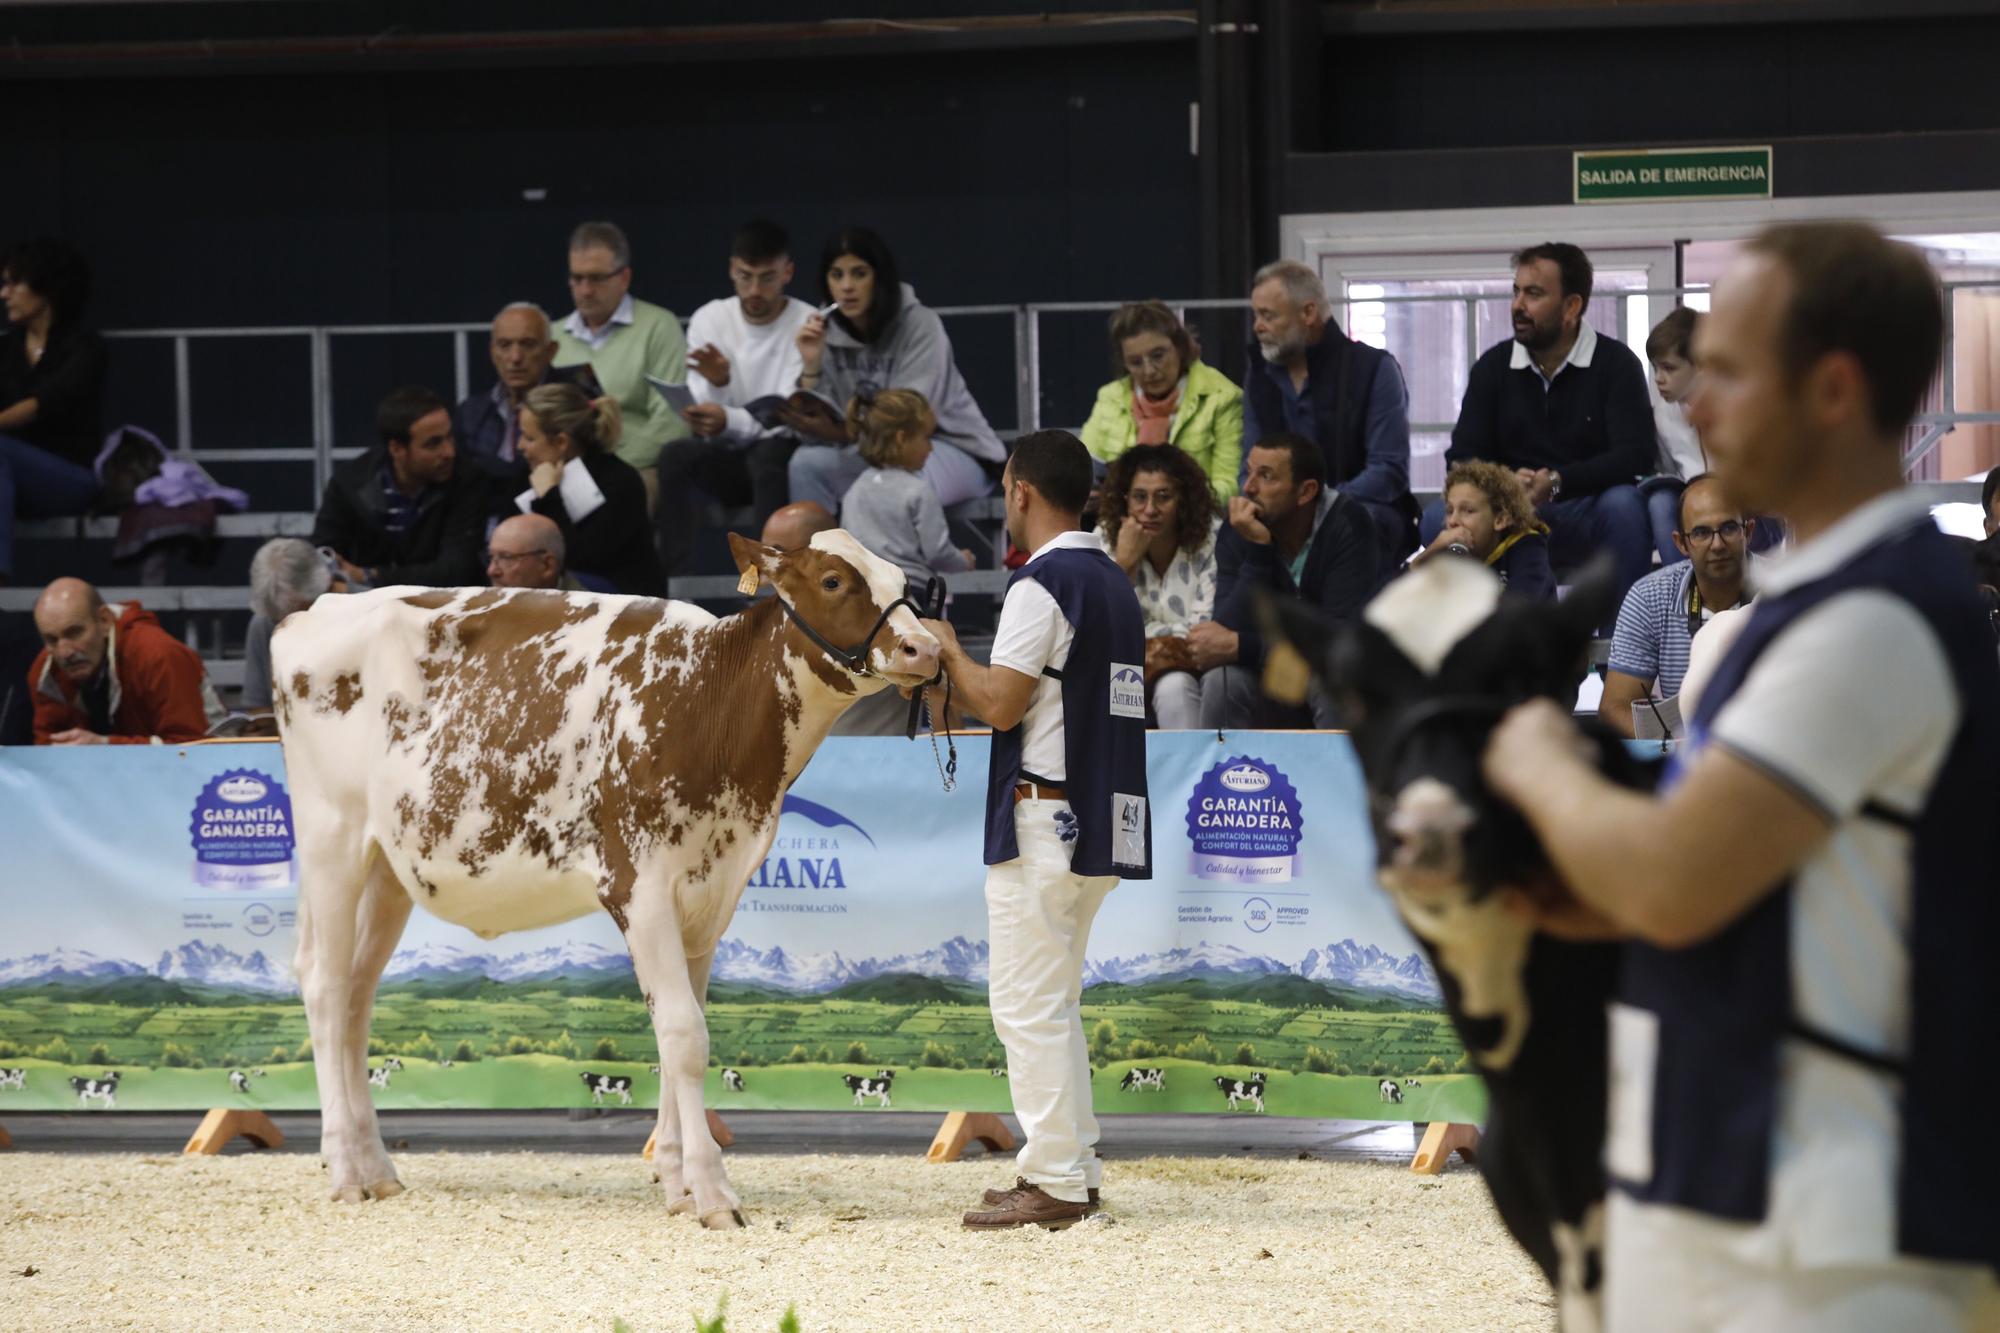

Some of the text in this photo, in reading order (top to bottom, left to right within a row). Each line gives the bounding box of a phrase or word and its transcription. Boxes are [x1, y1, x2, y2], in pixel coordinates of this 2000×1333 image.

[1580, 165, 1766, 185] SALIDA DE EMERGENCIA
[1202, 796, 1288, 813] GARANTÍA
[203, 804, 285, 822] GARANTÍA
[1198, 813, 1292, 829] GANADERA
[200, 823, 289, 838] GANADERA
[777, 838, 840, 849] CHERA
[1196, 832, 1296, 843] ALIMENTACIÓN NATURAL Y
[1202, 842, 1239, 850] CONFORT
[1254, 843, 1289, 852] GANADO
[747, 857, 847, 889] IANA
[1206, 863, 1238, 874] Calidad
[1246, 865, 1284, 876] bienestar
[751, 900, 848, 913] TRANSFORMACIÓN
[1276, 907, 1309, 915] APPROVED
[1250, 910, 1266, 921] SGS
